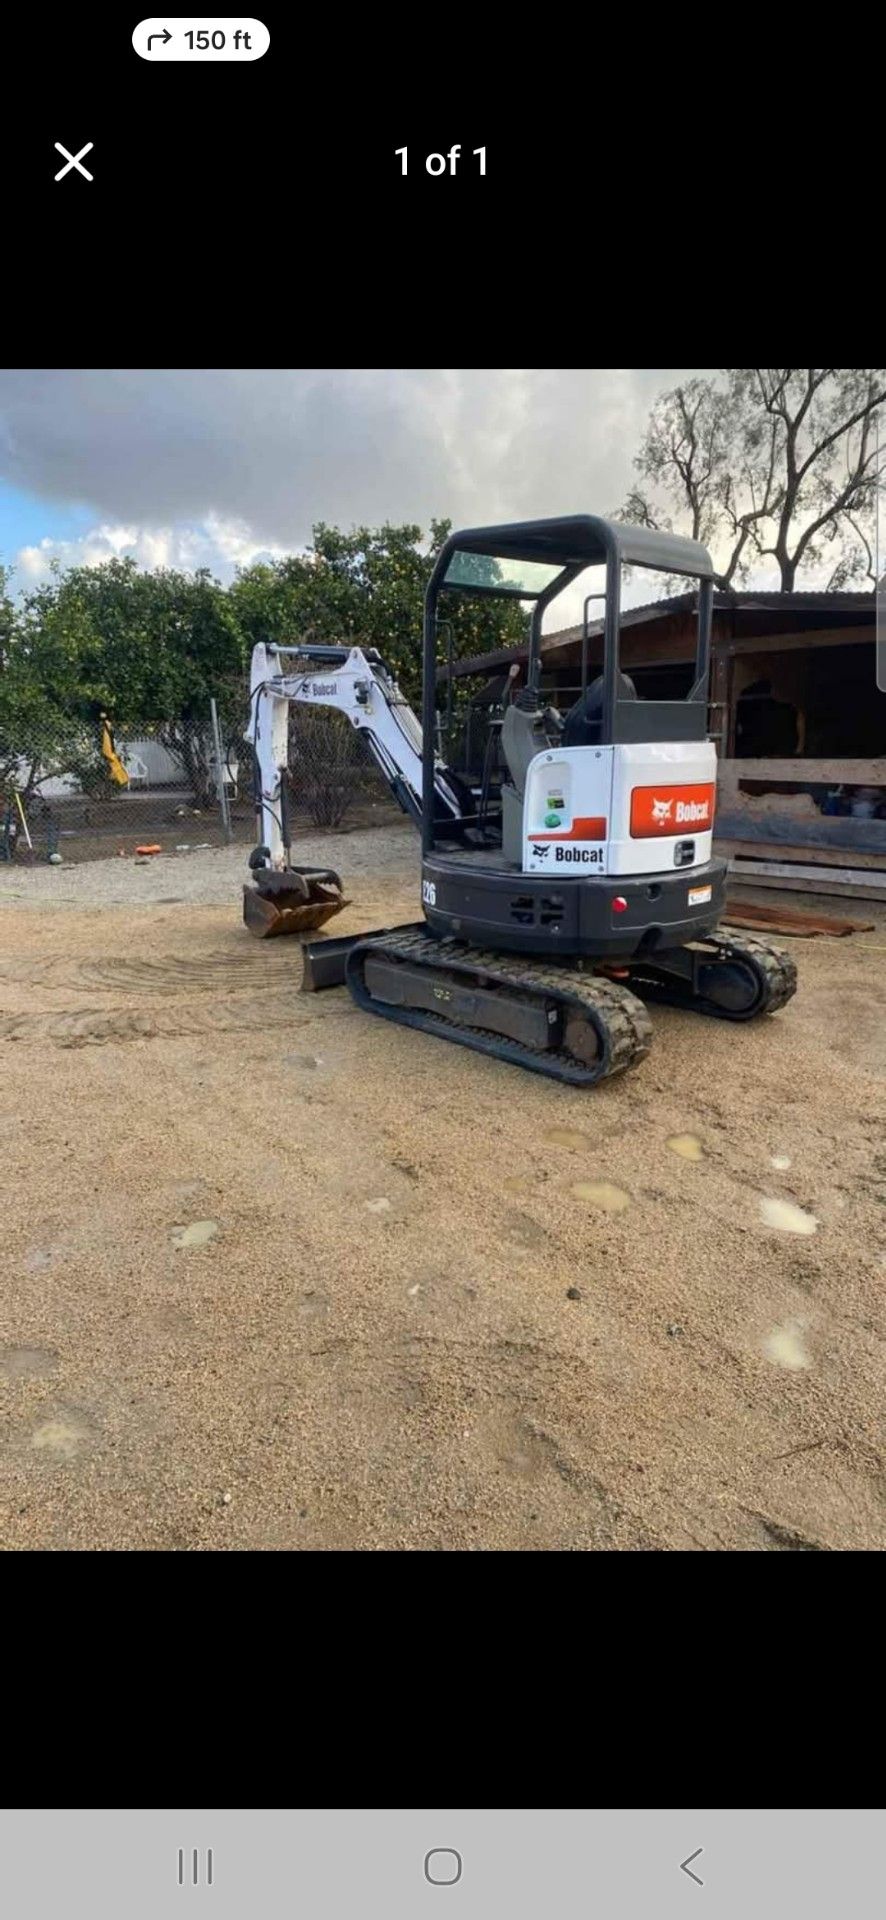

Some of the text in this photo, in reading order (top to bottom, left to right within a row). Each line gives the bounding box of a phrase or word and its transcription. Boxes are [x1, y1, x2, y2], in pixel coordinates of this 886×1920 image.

[312, 682, 337, 697] Bobcat
[675, 800, 709, 823] Bobcat
[555, 846, 604, 863] Bobcat
